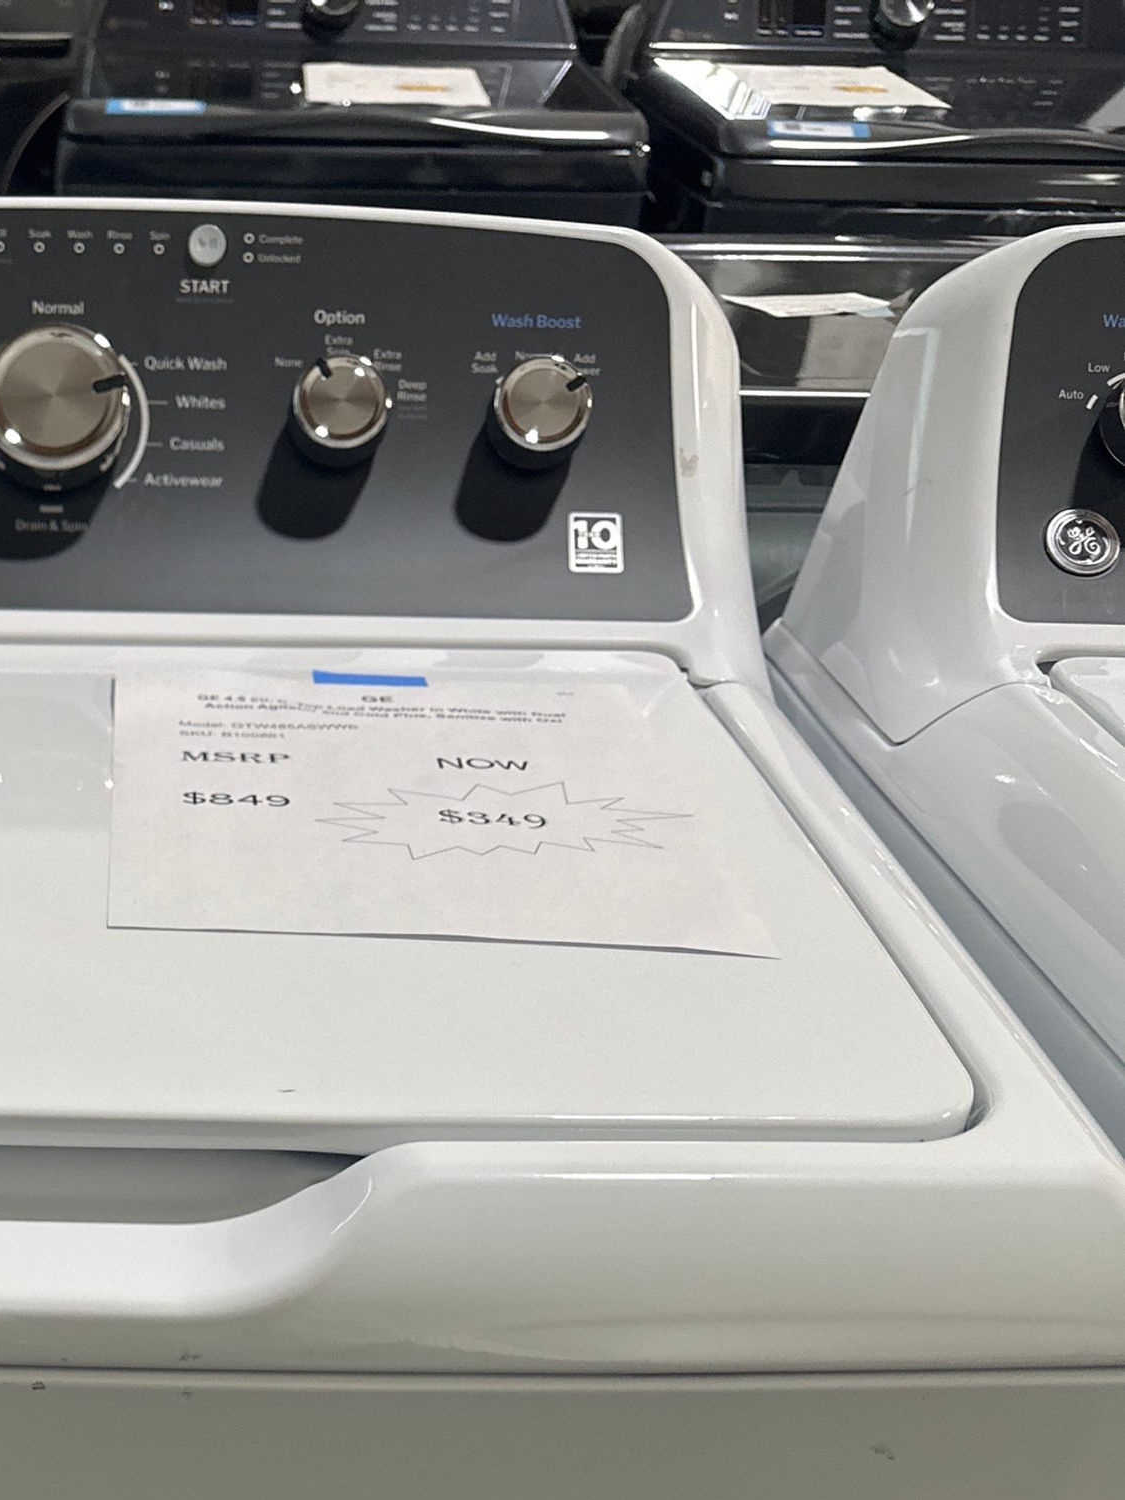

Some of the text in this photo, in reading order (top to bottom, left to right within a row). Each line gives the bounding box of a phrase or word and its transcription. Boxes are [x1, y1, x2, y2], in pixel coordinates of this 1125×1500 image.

[28, 229, 52, 239] Soak
[66, 230, 93, 240] Wash
[106, 230, 133, 241] Rinse
[149, 231, 171, 242] Spin
[258, 234, 304, 246] Complete
[179, 279, 230, 294] START
[32, 301, 85, 315] Normal
[314, 309, 366, 326] Option
[491, 313, 582, 329] Wash Boost
[325, 334, 353, 346] Extra
[374, 348, 402, 360] Extra
[475, 351, 497, 361] Add
[575, 353, 596, 363] Add
[144, 356, 228, 370] Quick Wash
[275, 357, 304, 368] None
[471, 363, 498, 373] Soak
[1087, 362, 1111, 373] Low
[398, 380, 427, 391] Deep
[1058, 389, 1084, 400] Auto
[175, 396, 226, 409] Whites
[170, 437, 225, 451] Casuals
[144, 473, 223, 487] Activewear
[15, 519, 46, 531] Drain
[575, 520, 619, 550] 10
[360, 694, 393, 703] GE
[368, 705, 425, 713] Washer
[181, 751, 290, 764] MSRP
[436, 757, 528, 771] NOW
[182, 792, 291, 807] $849
[438, 809, 546, 829] $349
